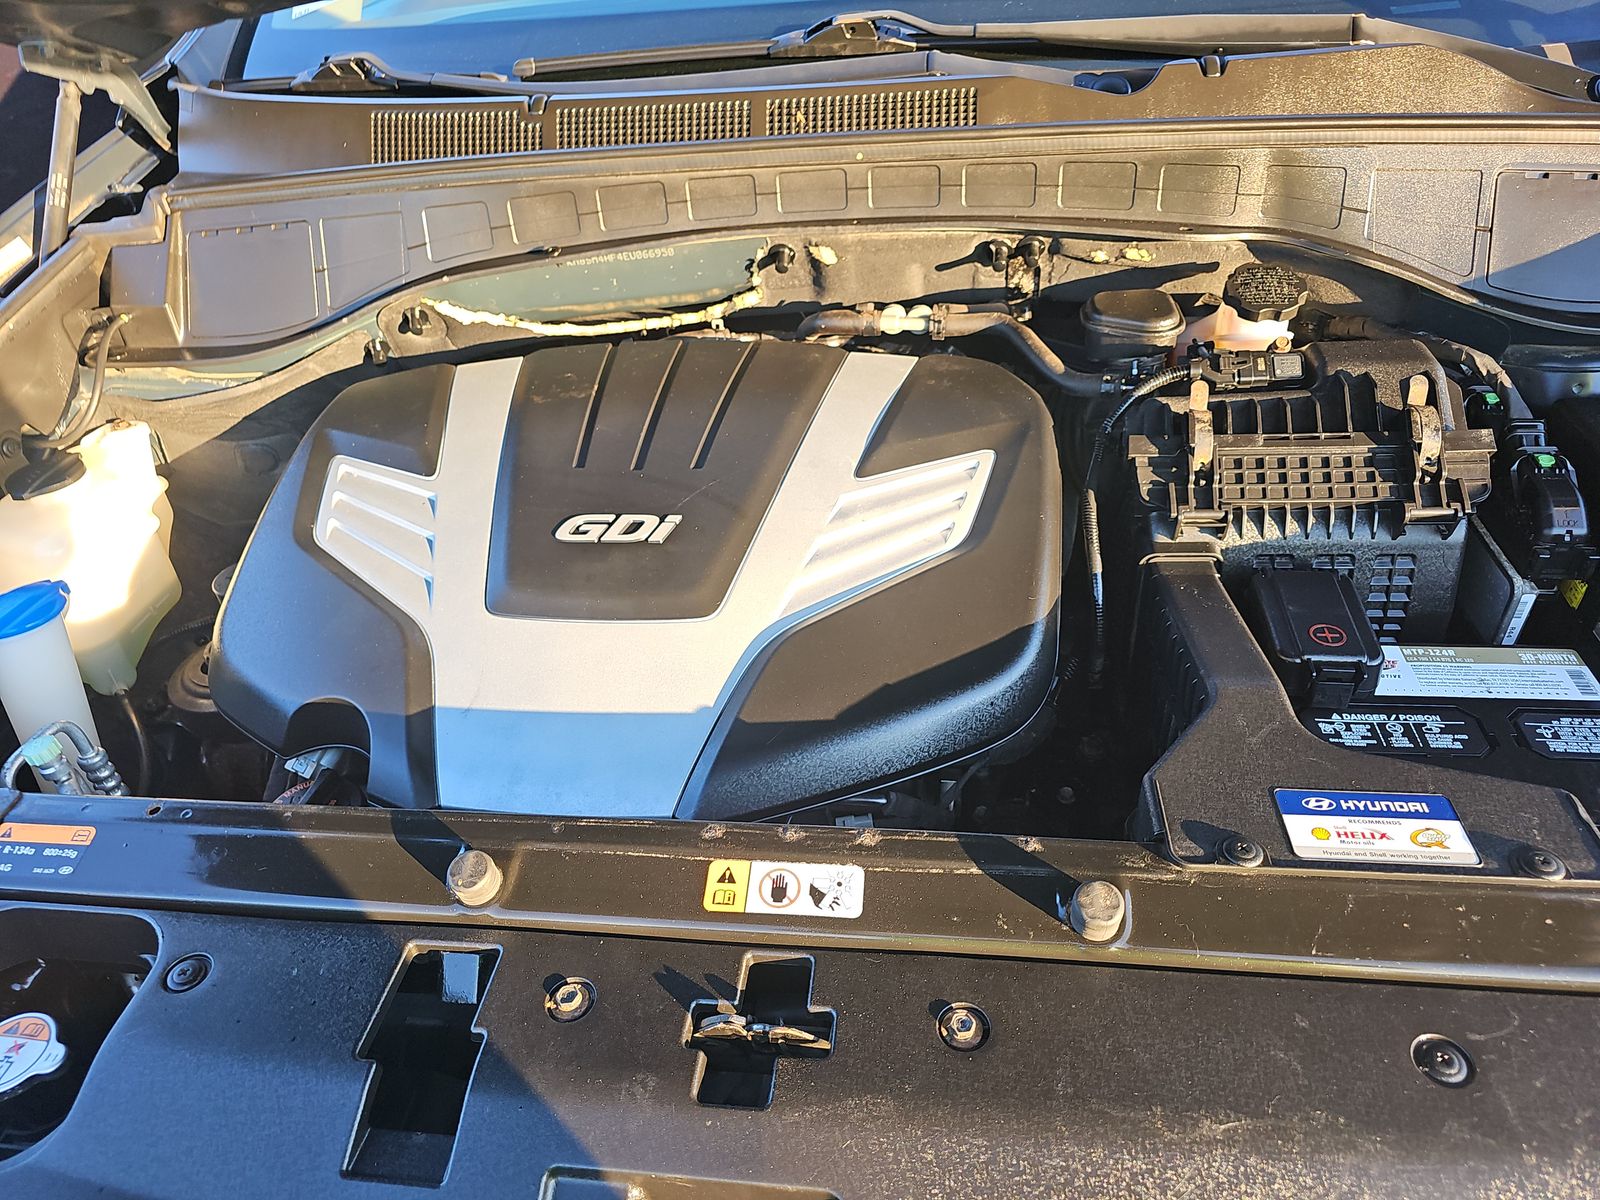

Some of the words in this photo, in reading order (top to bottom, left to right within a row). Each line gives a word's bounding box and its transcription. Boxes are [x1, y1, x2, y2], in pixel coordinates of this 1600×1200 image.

[552, 513, 683, 544] GDi
[1556, 519, 1578, 528] LOCK
[1402, 648, 1456, 657] MTP-124R
[1341, 713, 1388, 721] DANGER
[1399, 714, 1442, 722] POISON
[283, 780, 315, 798] MANU
[1340, 799, 1430, 813] HYUNDAI
[1348, 818, 1402, 826] RECOMMENDS
[1335, 830, 1393, 841] HELIX
[1322, 849, 1352, 857] Hyundai
[1389, 852, 1419, 861] working
[1420, 853, 1451, 861] together
